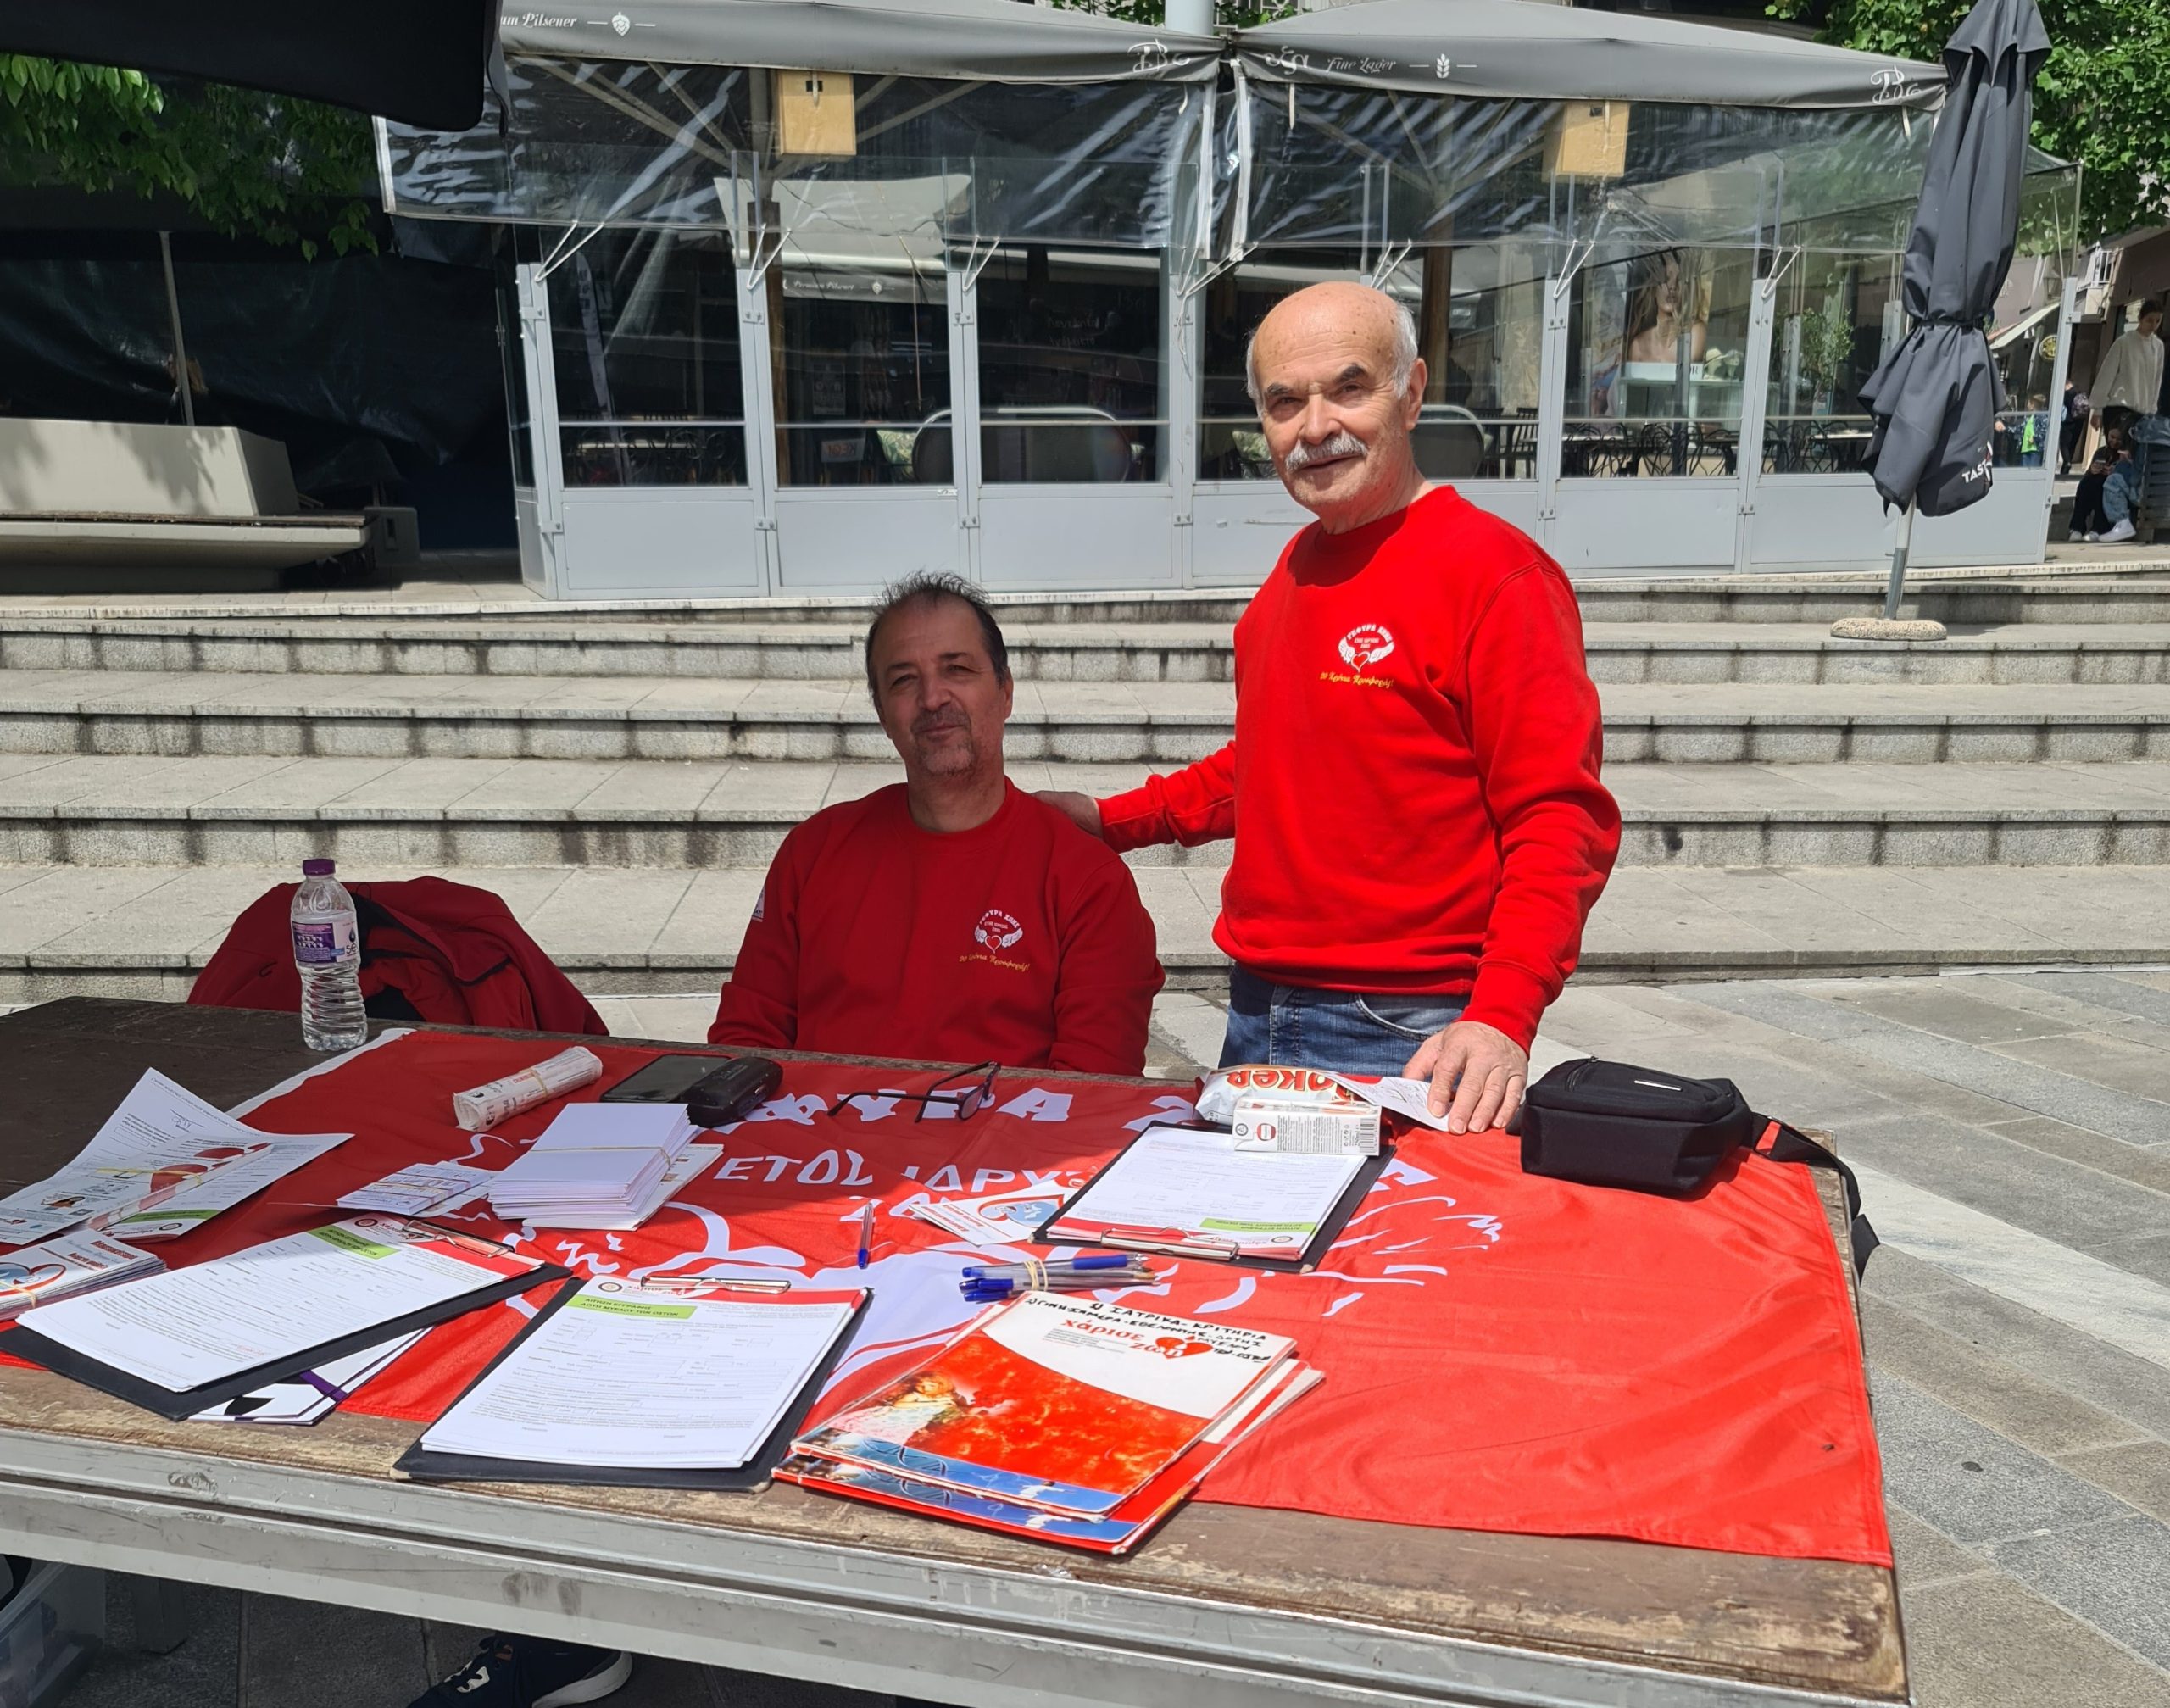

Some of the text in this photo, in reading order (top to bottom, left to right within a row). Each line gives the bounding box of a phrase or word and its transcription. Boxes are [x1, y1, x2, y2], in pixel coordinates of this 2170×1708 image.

[522, 12, 577, 28] Pilsener
[1360, 57, 1396, 74] Lager
[1060, 1319, 1145, 1341] χάρισε
[1193, 1323, 1266, 1340] ΚΡΙΤΗΡΙΑ
